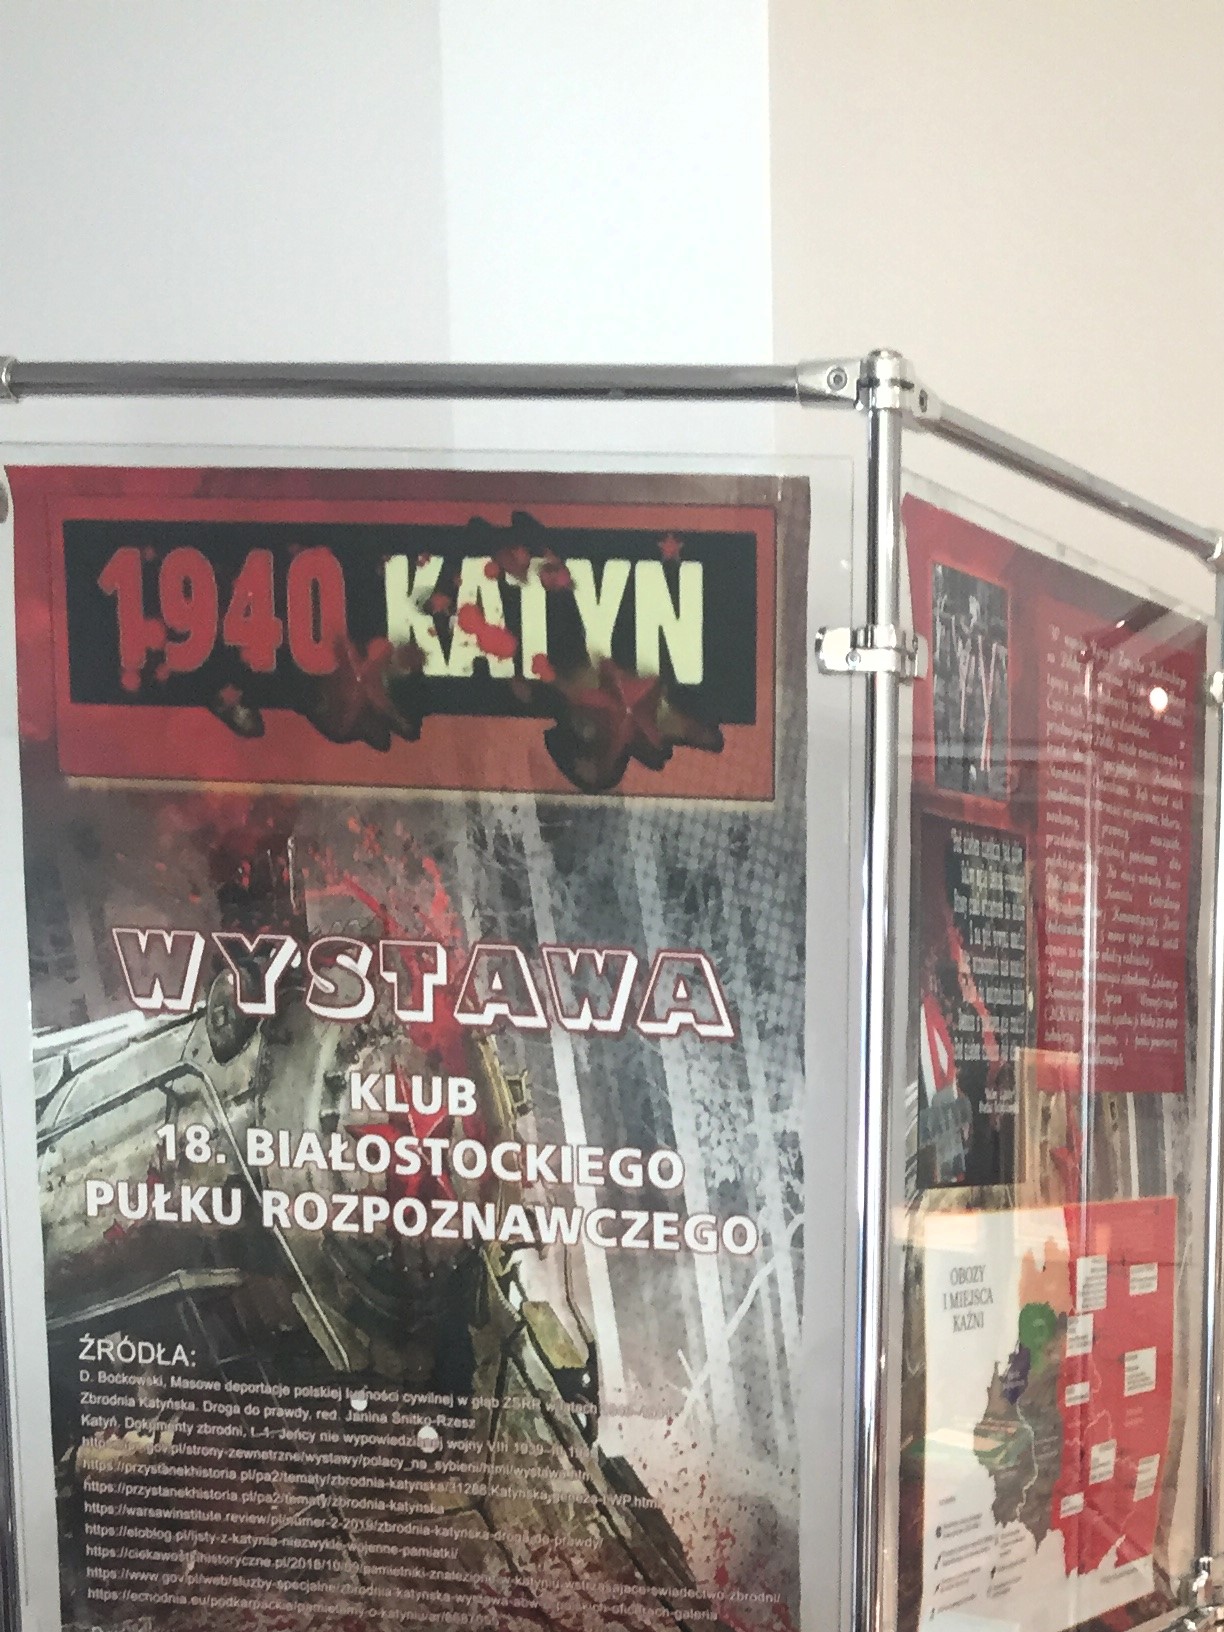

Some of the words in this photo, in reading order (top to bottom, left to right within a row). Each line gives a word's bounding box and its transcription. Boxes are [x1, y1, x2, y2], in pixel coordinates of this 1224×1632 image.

[97, 545, 347, 682] 1940
[112, 927, 738, 1040] WYSTAWA
[349, 1071, 478, 1116] KLUB
[156, 1125, 227, 1164] 18.
[246, 1126, 686, 1190] BIAŁOSTOCKIEGO
[85, 1179, 242, 1227] PUŁKU
[260, 1195, 760, 1256] ROZPOZNAWCZEGO
[950, 1264, 986, 1286] OBOZY
[949, 1287, 993, 1310] MIEJSCA
[78, 1332, 196, 1367] ŹRÓDŁA:
[80, 1392, 136, 1408] Zbrodnia
[203, 1400, 241, 1417] Droga
[244, 1403, 260, 1416] do
[170, 1375, 221, 1391] Masowe
[294, 1385, 342, 1402] polskiej
[402, 1391, 454, 1408] cywilnej
[457, 1396, 469, 1406] w
[319, 1431, 340, 1443] nie
[446, 1438, 484, 1454] wojny
